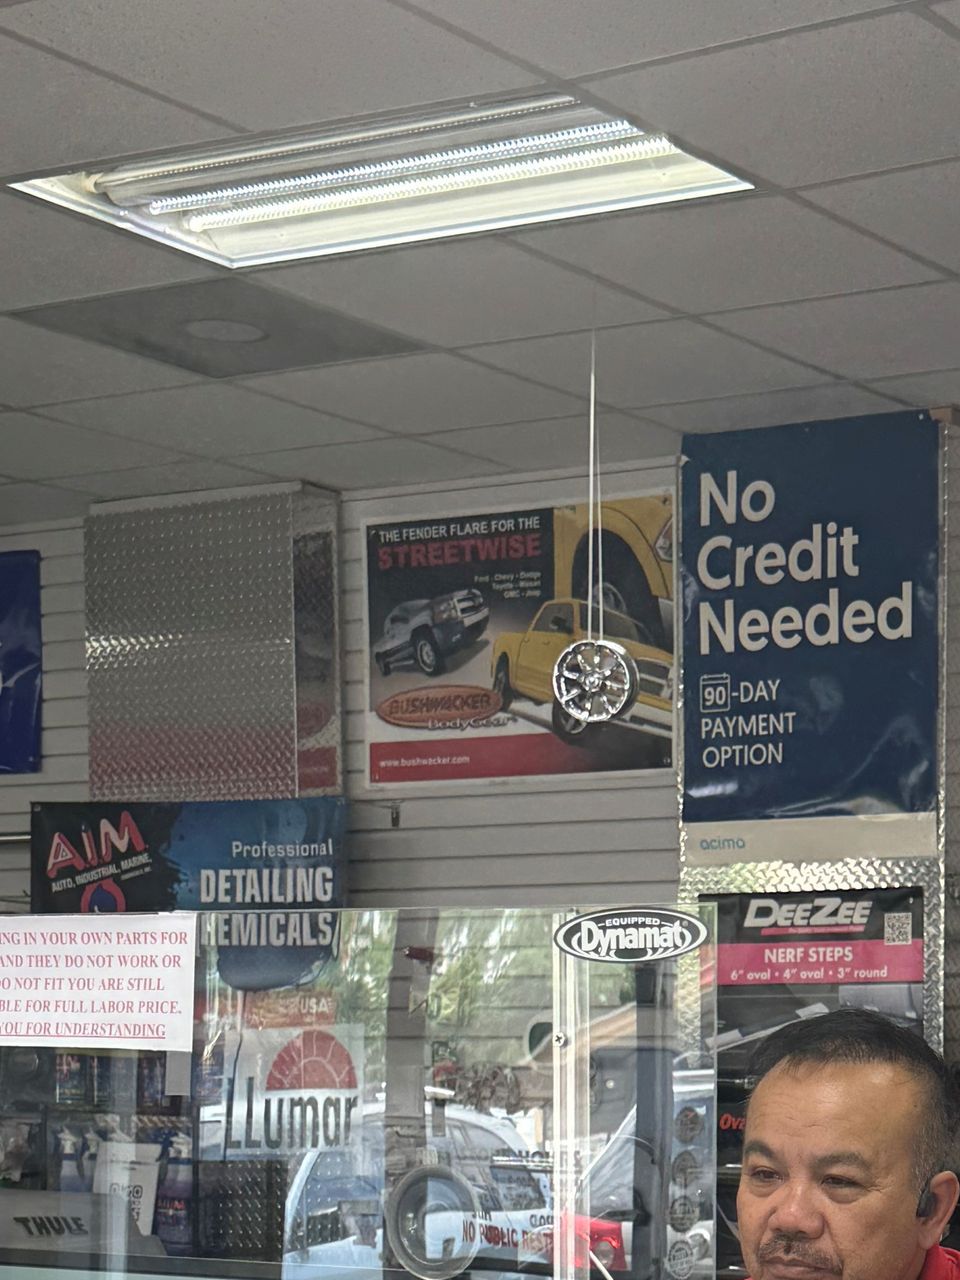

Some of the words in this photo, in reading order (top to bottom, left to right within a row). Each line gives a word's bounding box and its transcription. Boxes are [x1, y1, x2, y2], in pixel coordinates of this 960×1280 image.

[700, 470, 775, 527] No
[379, 530, 401, 544] THE
[403, 526, 447, 540] FENDER
[450, 522, 489, 536] FLARE
[491, 519, 515, 532] FOR
[518, 516, 541, 529] THE
[378, 533, 542, 570] STREETWISE
[698, 522, 859, 591] Credit
[700, 582, 912, 655] Needed
[701, 712, 796, 739] PAYMENT
[702, 742, 783, 768] OPTION
[232, 838, 334, 858] Professional
[700, 836, 746, 850] acima
[200, 866, 334, 903] DETAILING
[200, 912, 333, 947] HEMICALS
[605, 917, 660, 927] EQUIPPED
[24, 932, 37, 945] IN
[41, 932, 77, 945] YOUR
[81, 932, 113, 945] OWN
[116, 932, 157, 945] PARTS
[161, 932, 188, 945] FOR
[580, 920, 683, 957] Dynamat
[26, 954, 61, 968] THEY
[65, 955, 84, 968] DO
[86, 955, 114, 968] NOT
[118, 954, 159, 968] WORK
[162, 954, 182, 968] OR
[764, 948, 805, 964] NERF
[808, 947, 854, 962] STEPS
[747, 968, 771, 980] oval
[800, 967, 824, 979] oval
[854, 966, 888, 978] round
[25, 1000, 51, 1013] FOR
[54, 1000, 88, 1013] FULL
[91, 1000, 134, 1014] LABOR
[138, 1001, 182, 1015] PRICE.
[26, 1022, 51, 1035] FOR
[55, 1022, 166, 1037] UNDERSTANDING
[14, 1216, 88, 1236] THULE
